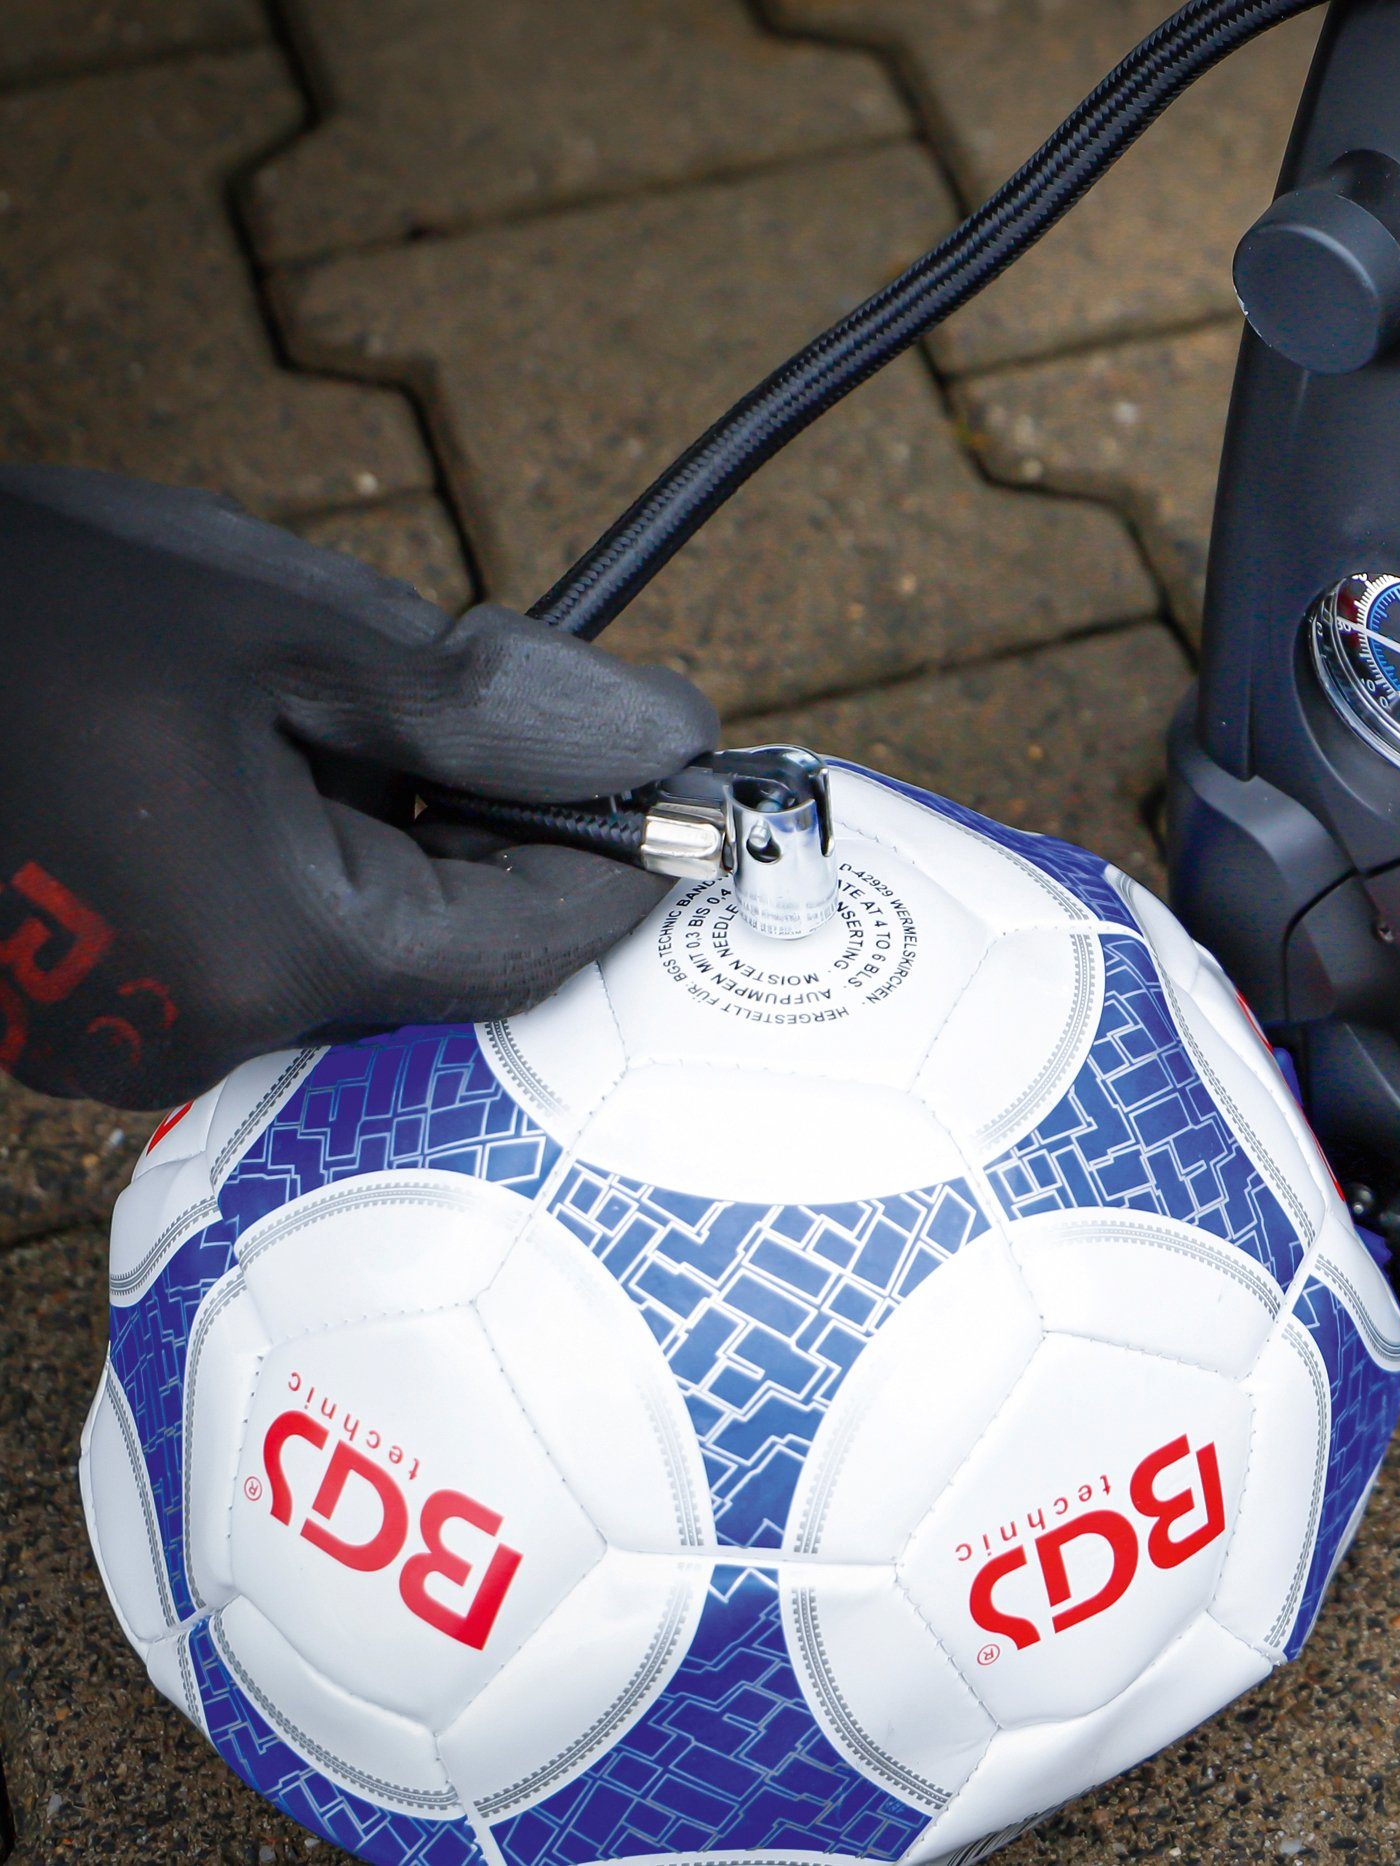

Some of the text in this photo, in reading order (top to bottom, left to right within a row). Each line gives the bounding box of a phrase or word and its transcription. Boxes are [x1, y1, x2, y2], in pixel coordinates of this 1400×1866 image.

[688, 907, 711, 928] BIS
[860, 901, 883, 915] AT
[658, 910, 682, 958] TECHNIC
[712, 904, 739, 958] NEEDLE
[834, 901, 864, 970] NSERTING
[875, 932, 891, 950] TO
[662, 959, 688, 982] BGS
[689, 953, 714, 974] MIT
[865, 899, 918, 1004] WERMELSKIRCHEN
[711, 973, 831, 1005] AUFPUMPEN
[728, 959, 819, 986] MOISTEN
[720, 1003, 849, 1025] HERGESTELLT
[288, 1372, 420, 1481] technic
[263, 1410, 523, 1650] BGS
[955, 1474, 1111, 1561] technic
[969, 1433, 1225, 1650] BGS
